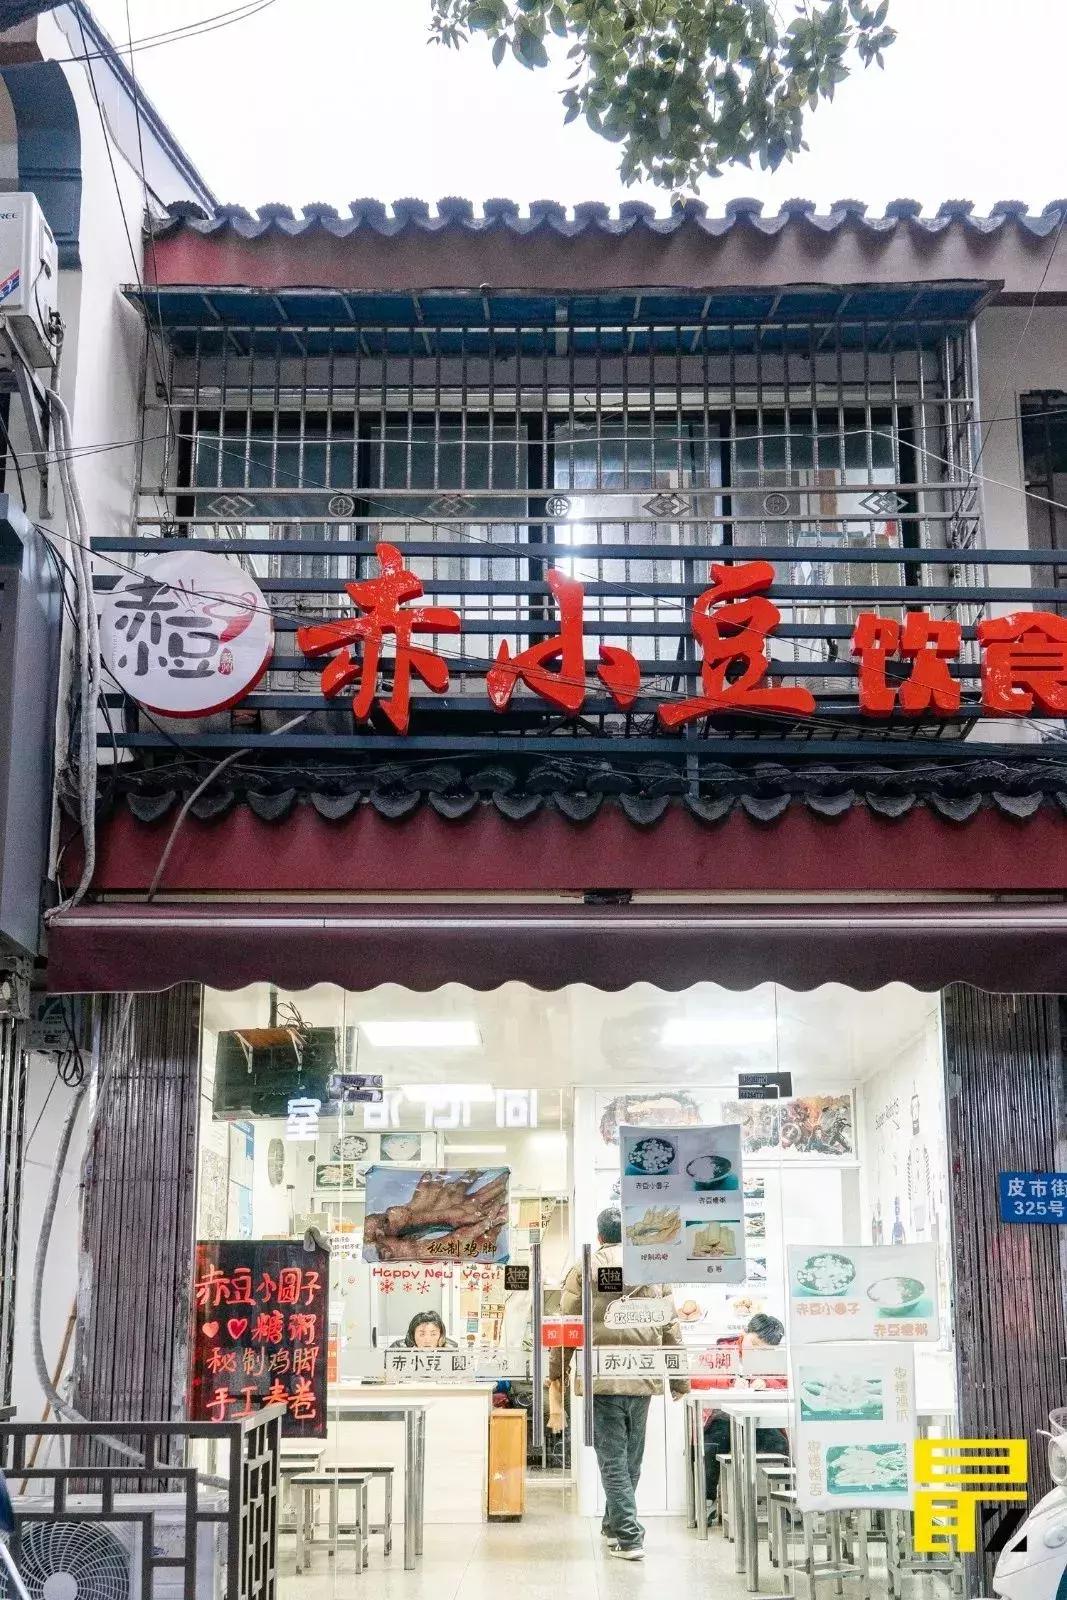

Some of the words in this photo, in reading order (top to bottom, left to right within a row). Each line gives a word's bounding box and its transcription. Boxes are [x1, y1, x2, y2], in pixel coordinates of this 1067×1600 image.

[1008, 1177, 1067, 1198] 皮市街
[1013, 1200, 1065, 1218] 325号
[426, 1239, 498, 1258] 秘制鸡脚
[372, 1267, 419, 1279] Happy
[425, 1268, 453, 1279] New
[462, 1269, 501, 1280] Year!
[194, 1263, 321, 1306] 赤豆小圆子
[206, 1345, 319, 1378] 秘制鸡脚
[393, 1355, 442, 1371] 赤小豆
[604, 1354, 656, 1370] 赤小豆
